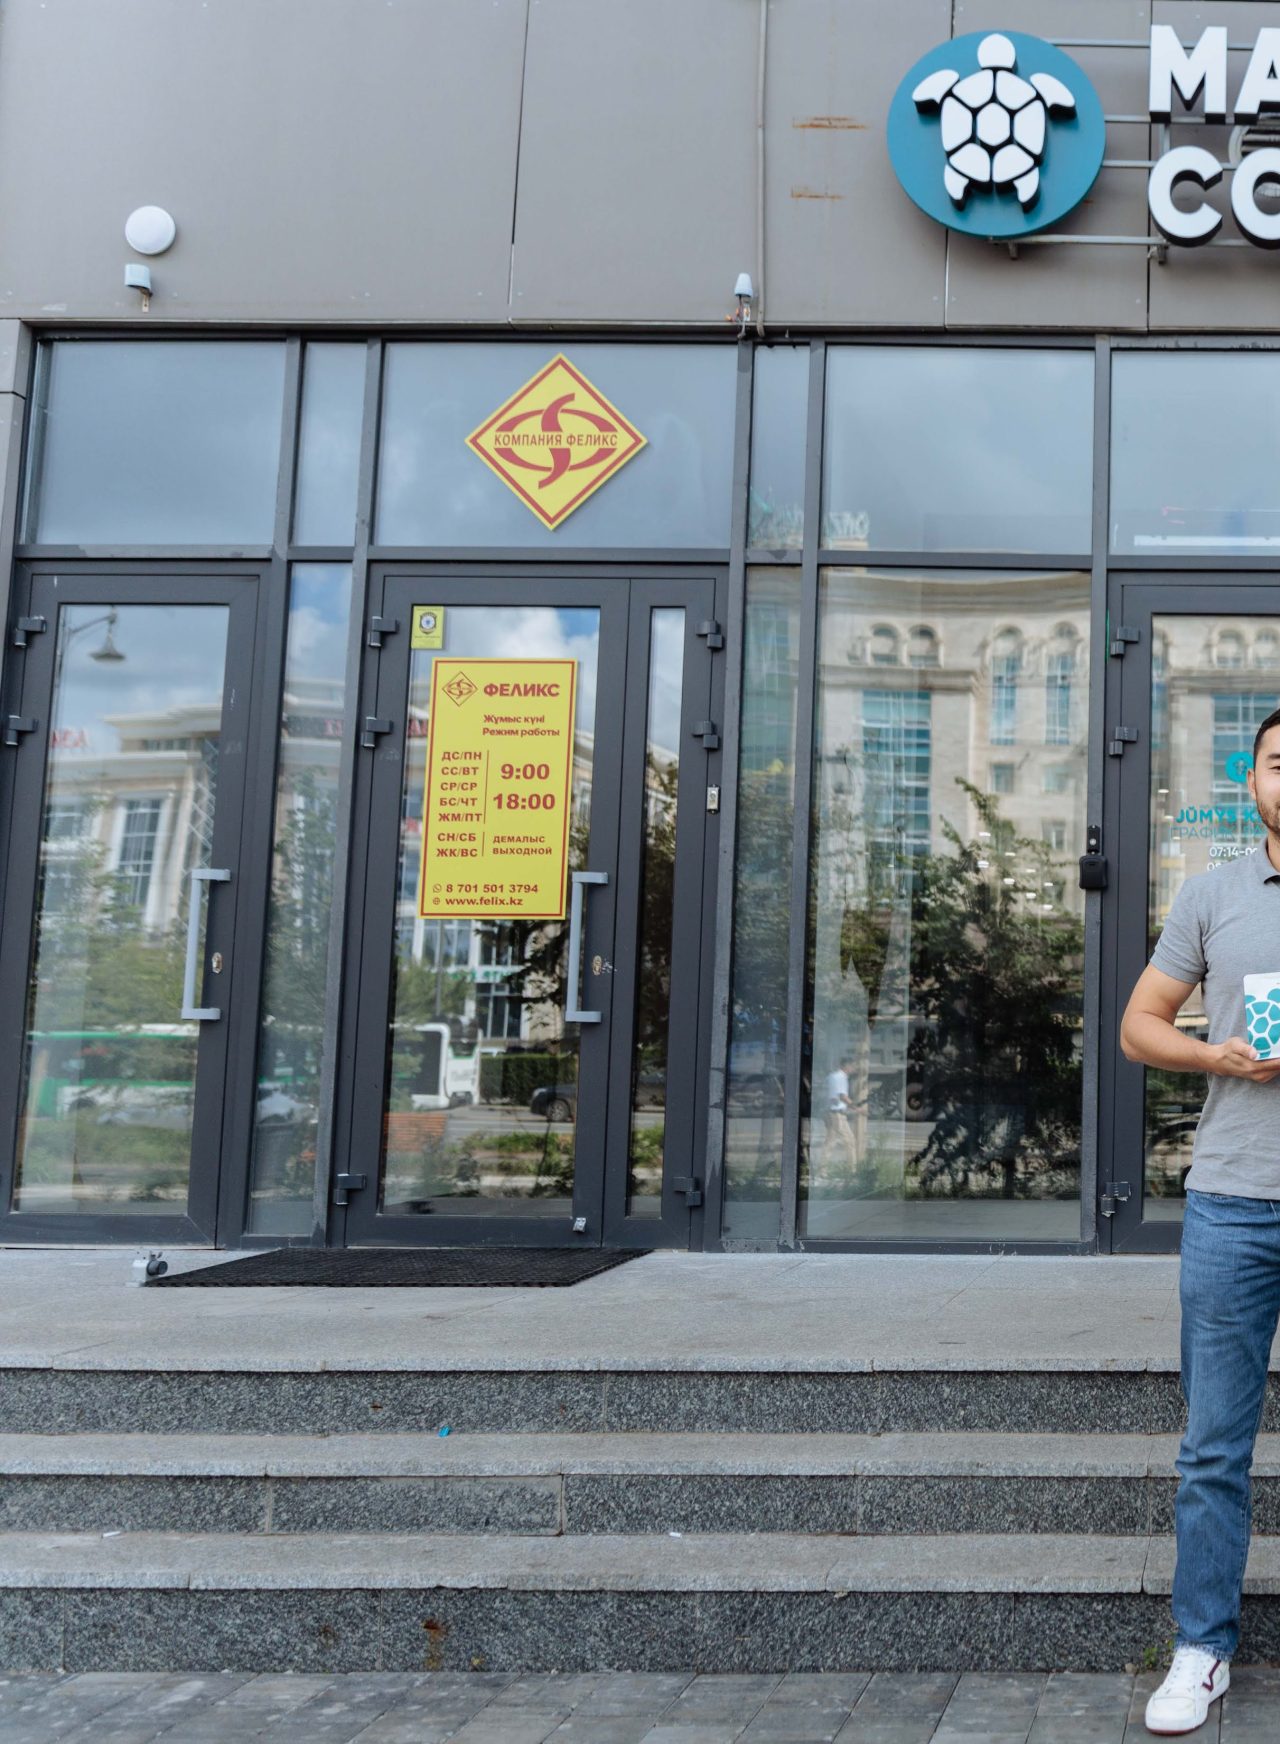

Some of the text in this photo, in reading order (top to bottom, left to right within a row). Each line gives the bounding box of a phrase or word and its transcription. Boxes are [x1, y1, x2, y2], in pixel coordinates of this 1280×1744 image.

[494, 433, 618, 446] КОМПАНИЯ ФЕЛИКС
[483, 682, 560, 697] ФЕЛИКС
[482, 727, 560, 738] Режим работы
[441, 751, 482, 762] ДС/ПН
[441, 766, 479, 776] СС/ВТ
[500, 763, 550, 780] 9:00
[440, 781, 478, 791] СР/СР
[439, 797, 478, 807] БС/ЧТ
[493, 793, 556, 810] 18:00
[438, 812, 483, 822] ЖМ/ПТ
[437, 832, 476, 842] СН/СБ
[492, 835, 545, 844] ДЕМАЛЫС
[436, 848, 478, 858] ЖК/ВС
[492, 846, 552, 856] ВЫХОДНОЙ
[446, 883, 538, 893] 8 701 501 3794
[445, 896, 524, 906] www.felix.kz
